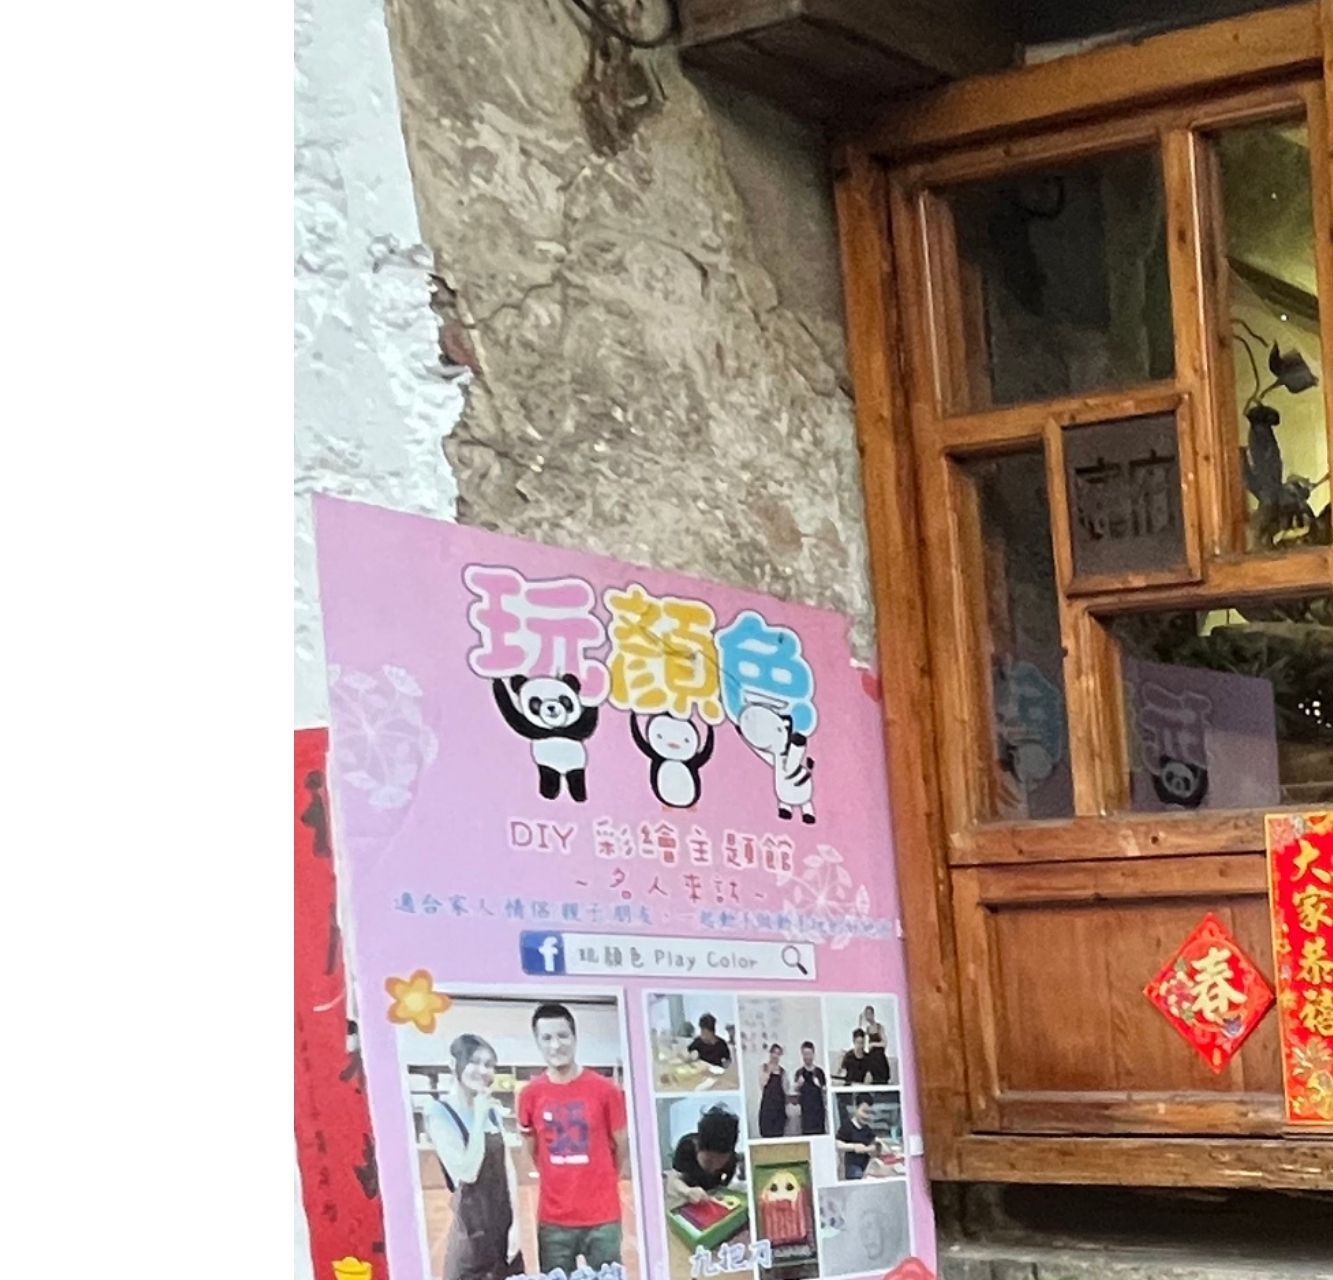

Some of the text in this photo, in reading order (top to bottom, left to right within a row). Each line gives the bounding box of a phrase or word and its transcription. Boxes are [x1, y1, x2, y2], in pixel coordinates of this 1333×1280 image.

[462, 563, 818, 736] 玩顏色
[509, 818, 795, 871] DIY 彩繪主題館
[655, 949, 696, 972] Play
[706, 950, 760, 970] Color
[1190, 946, 1247, 1016] 春
